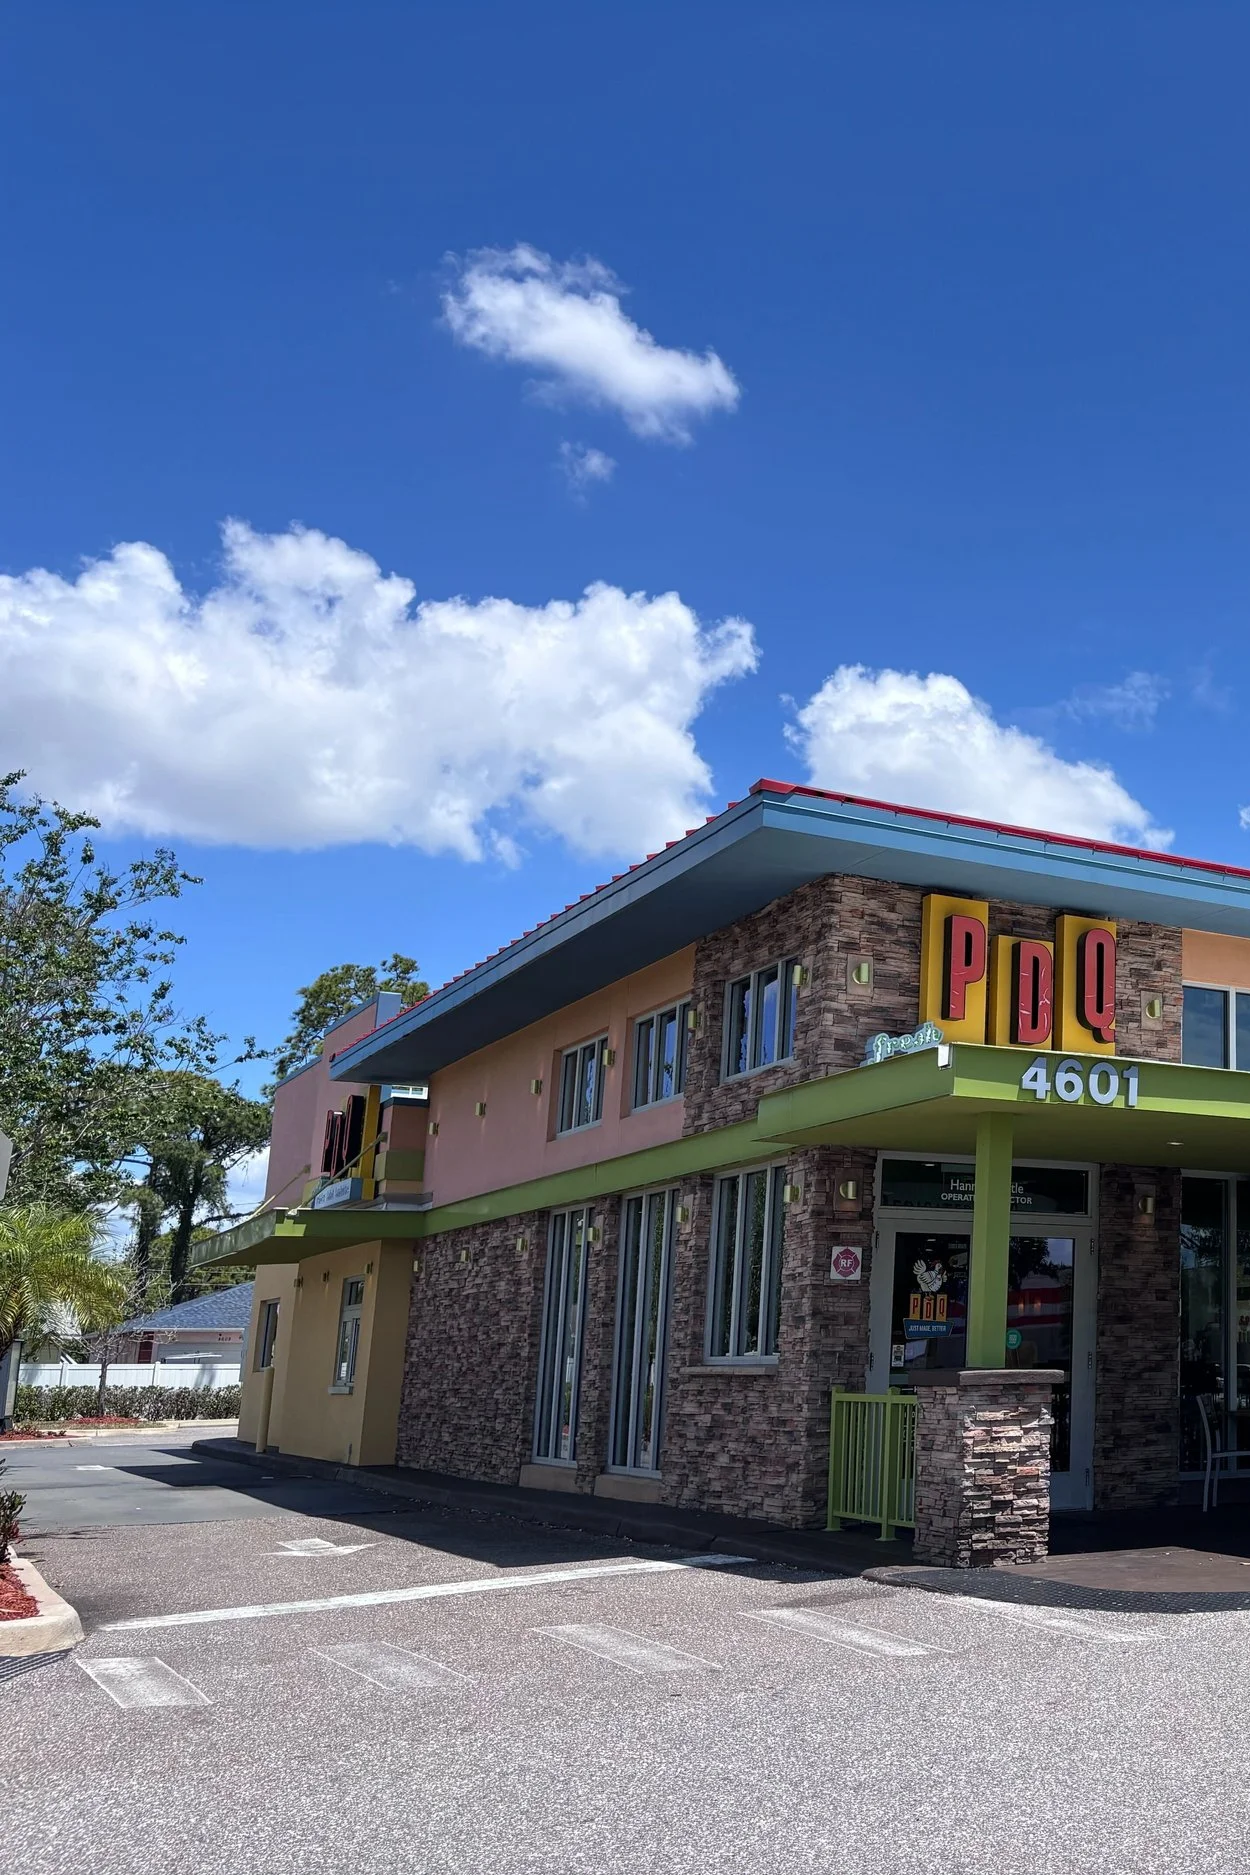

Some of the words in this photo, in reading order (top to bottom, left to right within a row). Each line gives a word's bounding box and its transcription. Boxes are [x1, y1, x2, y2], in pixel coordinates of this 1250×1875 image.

[943, 914, 1117, 1044] PDQ
[1021, 1056, 1139, 1108] 4601
[840, 1259, 853, 1267] RF
[912, 1297, 945, 1319] PDQ
